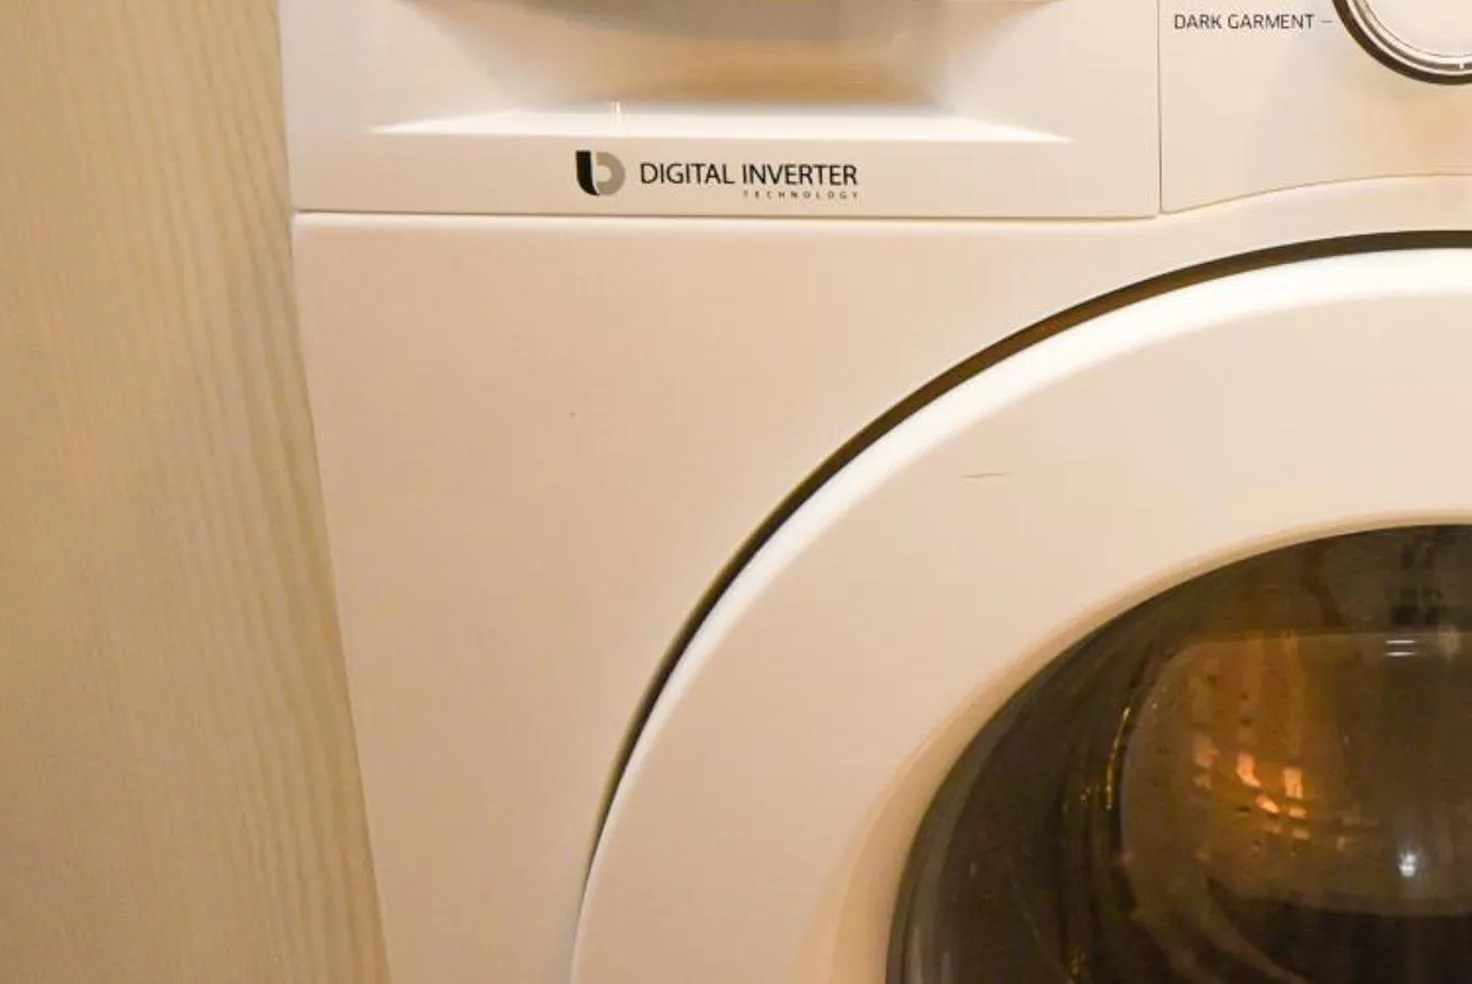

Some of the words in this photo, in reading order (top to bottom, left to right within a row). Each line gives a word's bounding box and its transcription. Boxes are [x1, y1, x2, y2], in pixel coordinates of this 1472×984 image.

[1175, 14, 1222, 29] DARK
[1228, 14, 1314, 29] GARMENT
[640, 163, 735, 184] DIGITAL
[742, 164, 857, 185] INVERTER
[744, 190, 857, 199] TECHNOLOGY
